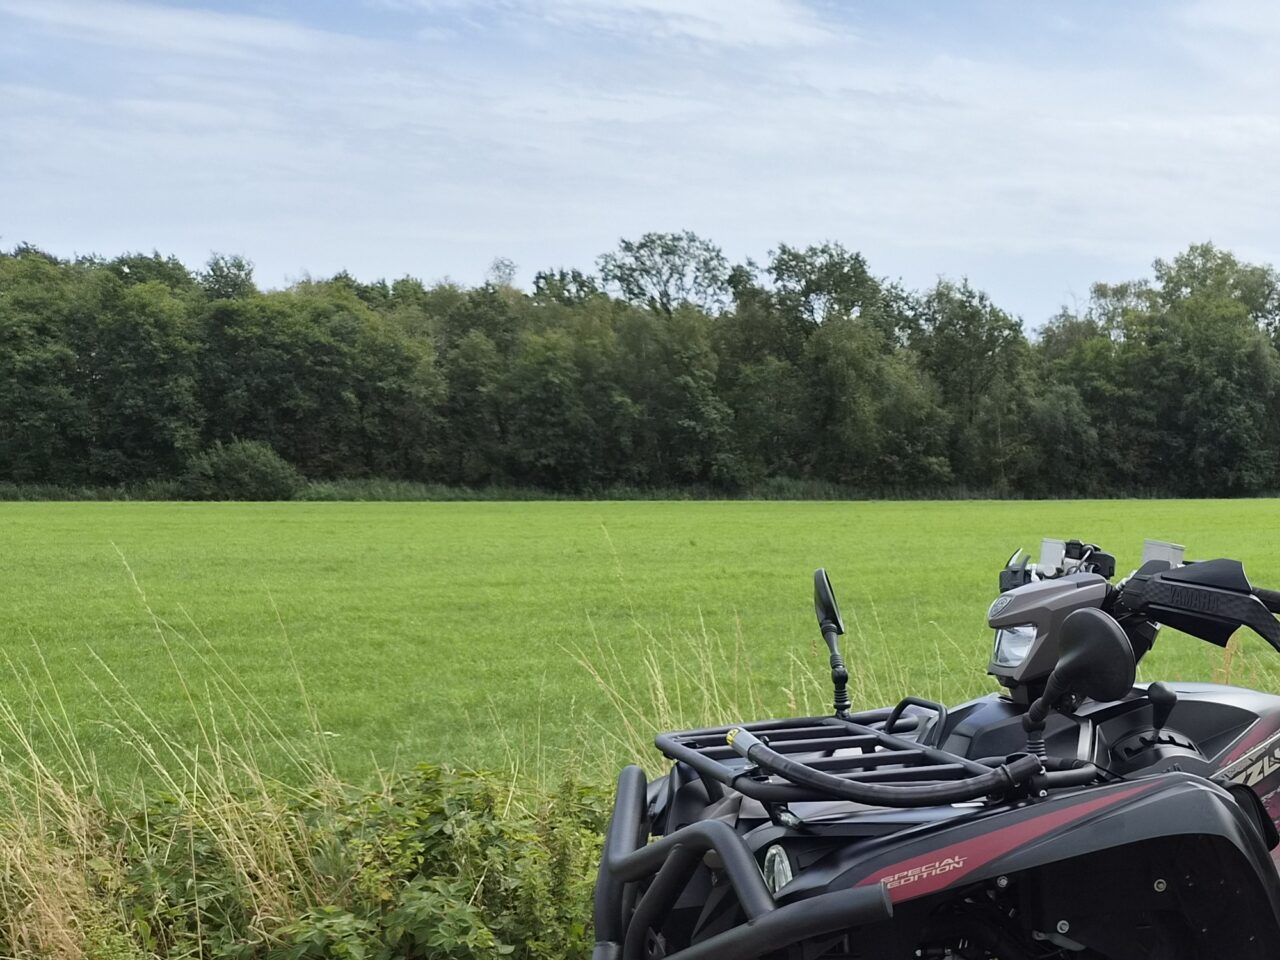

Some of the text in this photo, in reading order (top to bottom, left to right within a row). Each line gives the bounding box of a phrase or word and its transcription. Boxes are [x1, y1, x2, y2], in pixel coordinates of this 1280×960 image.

[1169, 585, 1219, 612] YAMAHA
[881, 855, 969, 883] SPECIAL
[886, 860, 965, 890] EDITION
